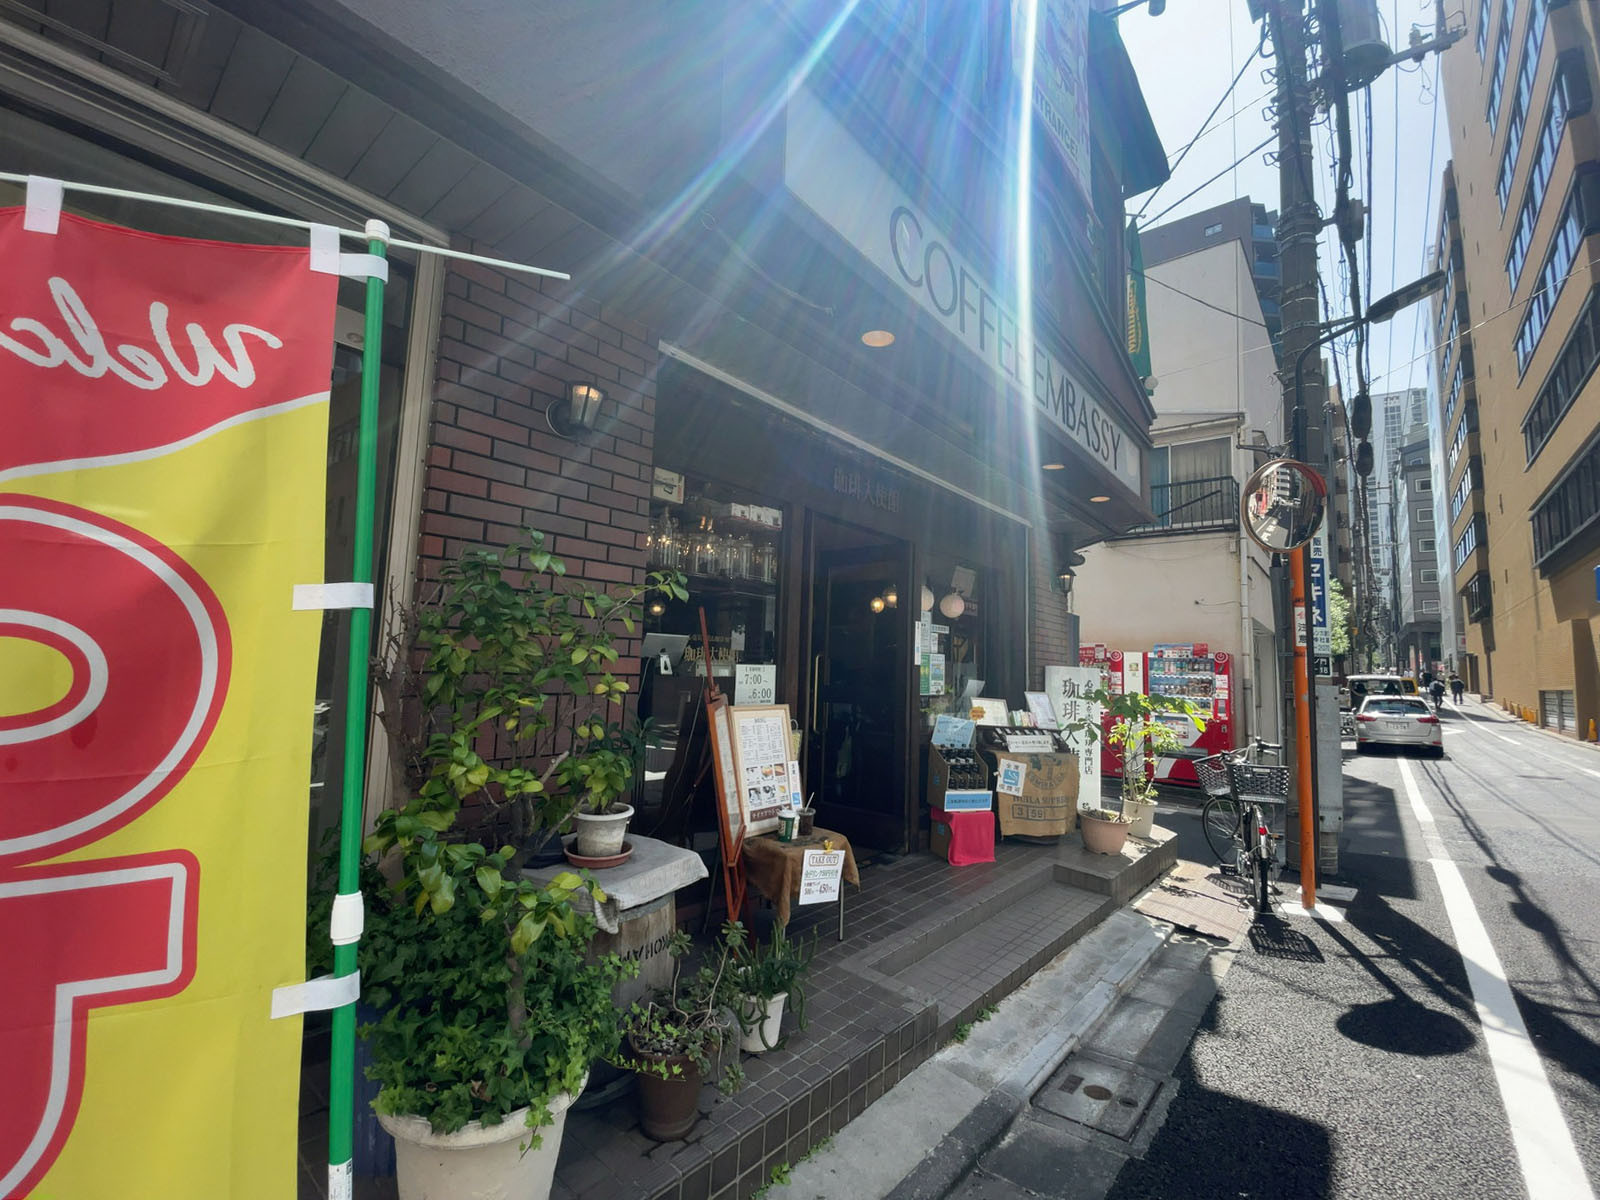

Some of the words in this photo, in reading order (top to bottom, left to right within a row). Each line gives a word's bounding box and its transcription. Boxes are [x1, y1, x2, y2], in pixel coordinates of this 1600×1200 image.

[1033, 342, 1122, 471] EMBASSY
[811, 856, 825, 864] TAKE
[826, 856, 838, 864] OUT
